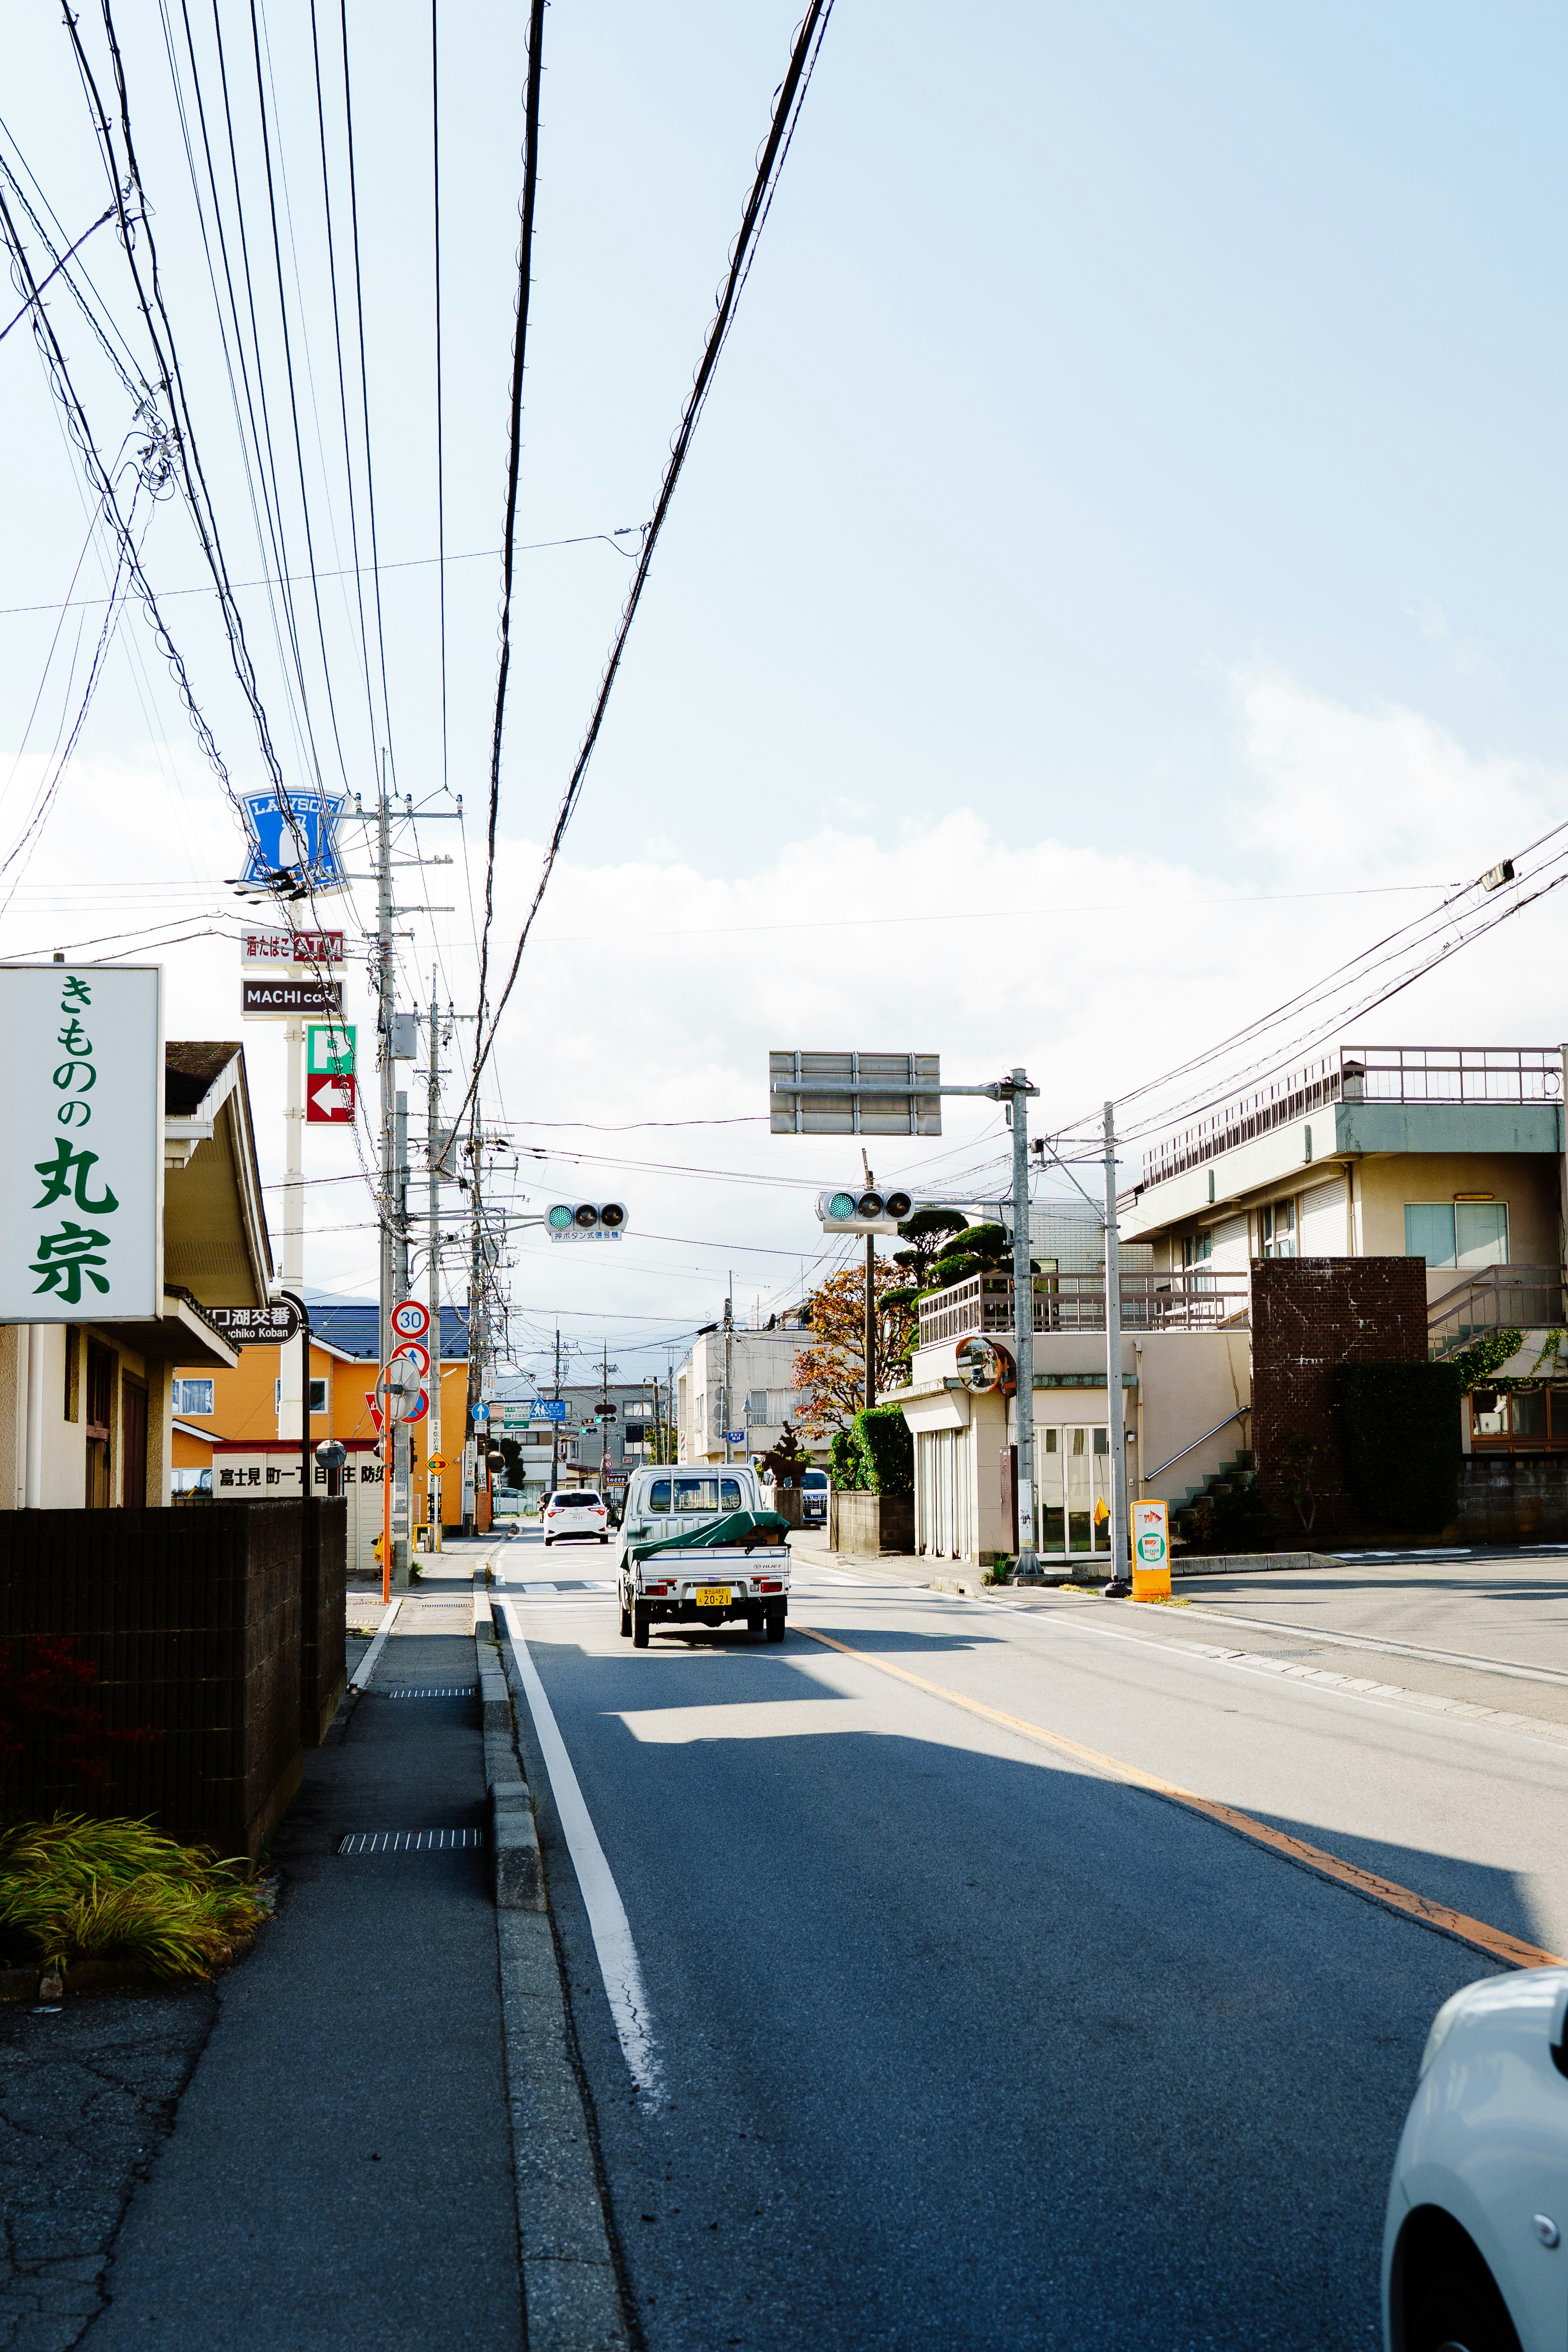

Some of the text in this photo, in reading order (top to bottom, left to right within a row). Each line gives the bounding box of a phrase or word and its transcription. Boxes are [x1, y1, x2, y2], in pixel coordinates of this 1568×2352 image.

[248, 990, 301, 1003] MACHI
[314, 1031, 352, 1069] P
[555, 1231, 619, 1240] 押ボタン式信号機
[206, 1306, 290, 1326] 口湖交番
[400, 1311, 421, 1328] 30
[228, 1328, 288, 1338] chiko Koban
[704, 1595, 728, 1604] 20-21
